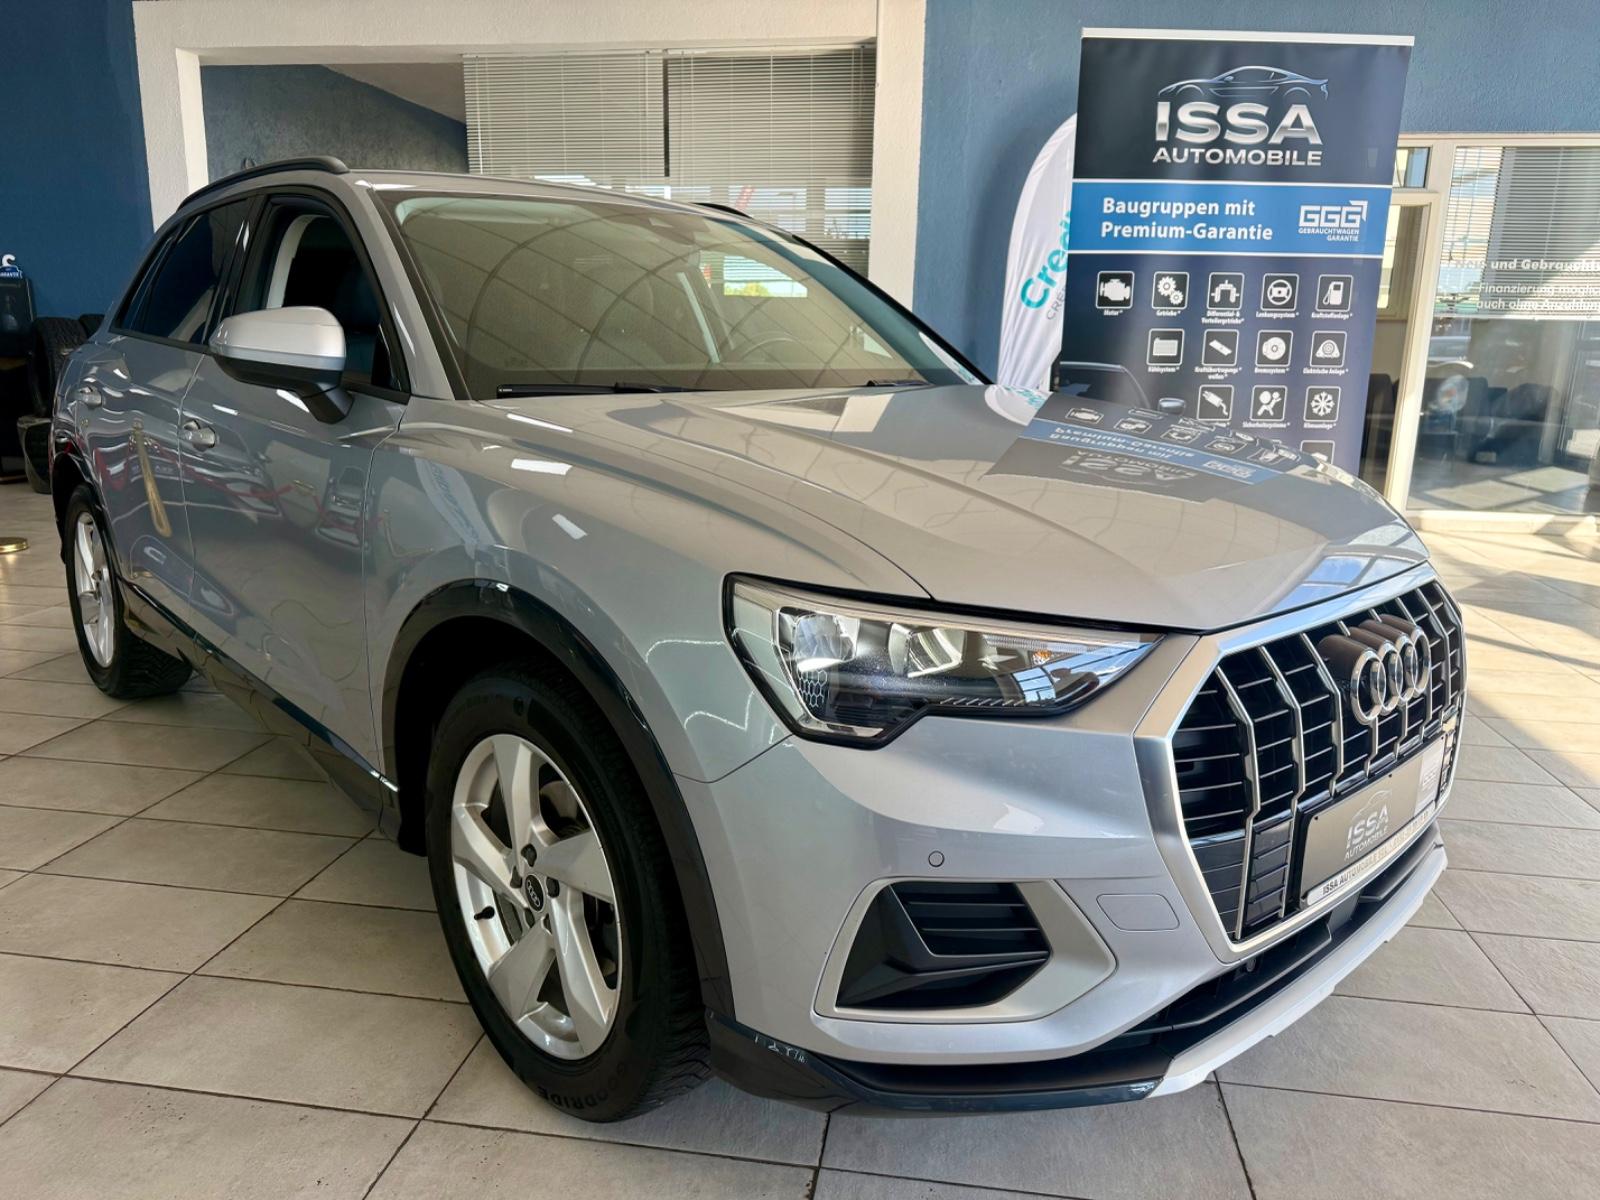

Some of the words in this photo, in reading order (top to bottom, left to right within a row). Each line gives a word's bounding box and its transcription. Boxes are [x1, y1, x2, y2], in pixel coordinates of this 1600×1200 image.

[1154, 101, 1323, 145] ISSA
[1152, 147, 1322, 166] AUTOMOBILE
[1103, 197, 1219, 219] Baugruppen
[1225, 198, 1255, 216] mit
[1299, 205, 1362, 227] GGG
[1101, 222, 1272, 242] Premium-Garantie
[1298, 227, 1360, 235] GEBRAUCHTWAGEN
[1327, 234, 1359, 242] GARANTIE
[1347, 804, 1388, 850] ISSA
